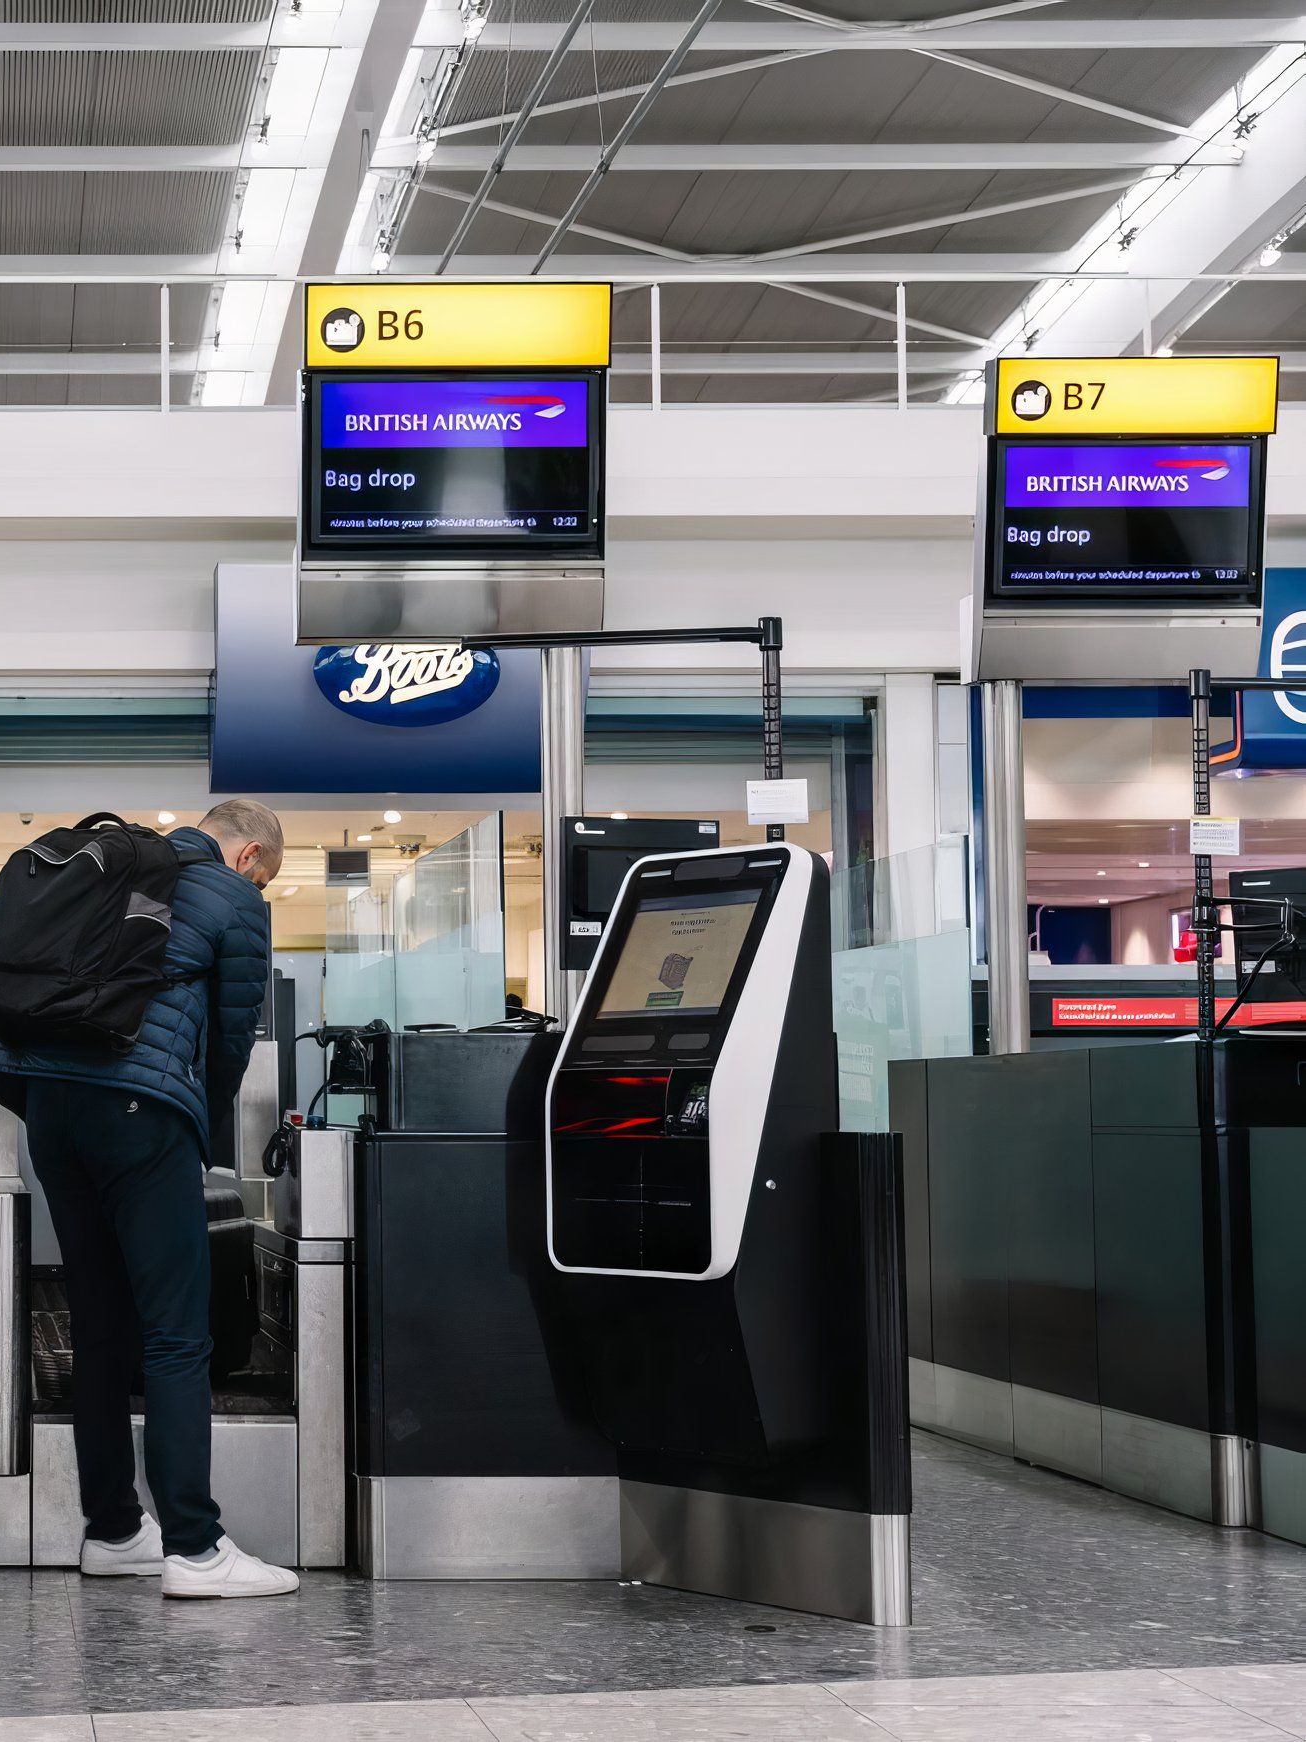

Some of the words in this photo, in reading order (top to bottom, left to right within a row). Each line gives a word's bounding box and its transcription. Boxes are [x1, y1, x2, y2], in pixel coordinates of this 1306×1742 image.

[377, 309, 424, 341] B6
[1063, 382, 1106, 411] B7
[345, 413, 427, 432] BRITISH
[433, 413, 522, 431] AIRWAYS
[325, 470, 362, 491] Bag
[368, 468, 416, 491] drop
[1026, 475, 1102, 492] BRITISH
[1107, 475, 1189, 492] AIRWAYS
[1007, 526, 1041, 546] Bag
[1047, 525, 1091, 546] drop
